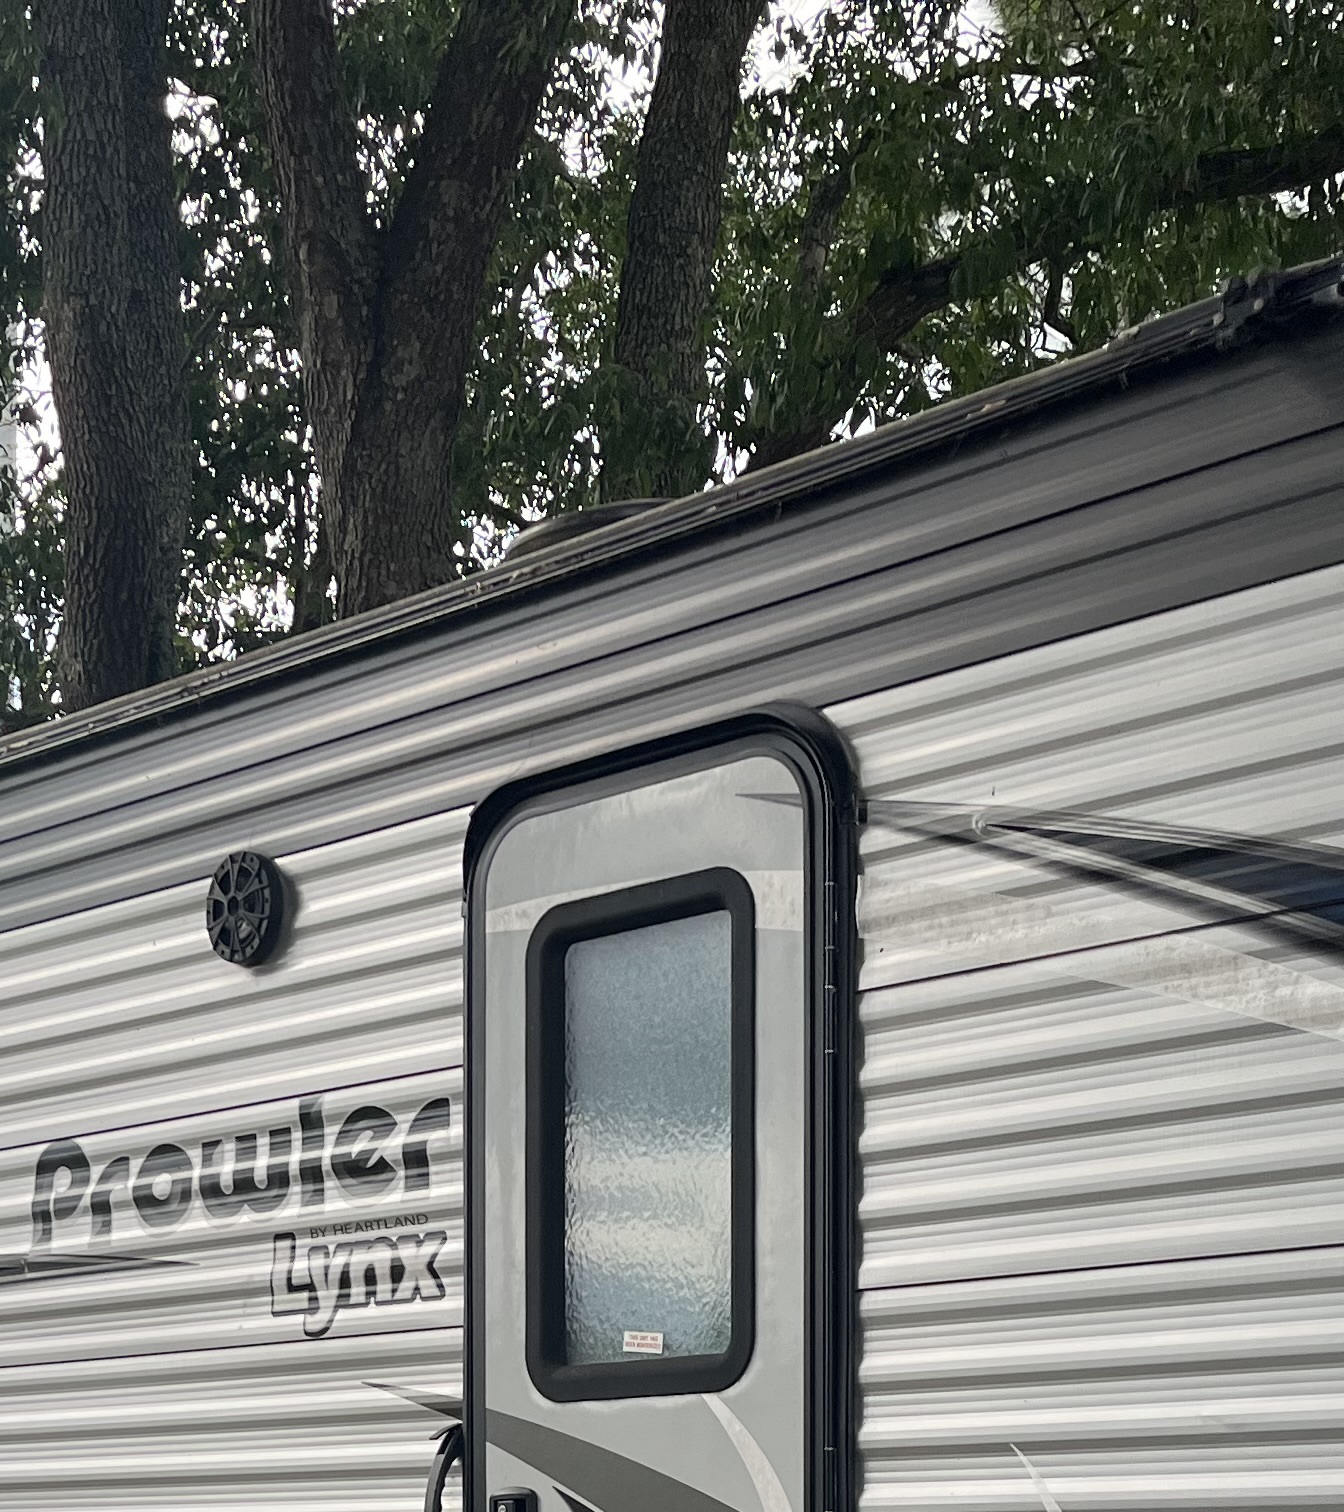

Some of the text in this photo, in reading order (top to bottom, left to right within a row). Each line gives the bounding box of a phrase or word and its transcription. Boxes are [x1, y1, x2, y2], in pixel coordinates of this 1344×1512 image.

[30, 1095, 452, 1253] Prowler
[309, 1213, 429, 1239] BY HEARTLAND
[270, 1231, 447, 1337] Lynx
